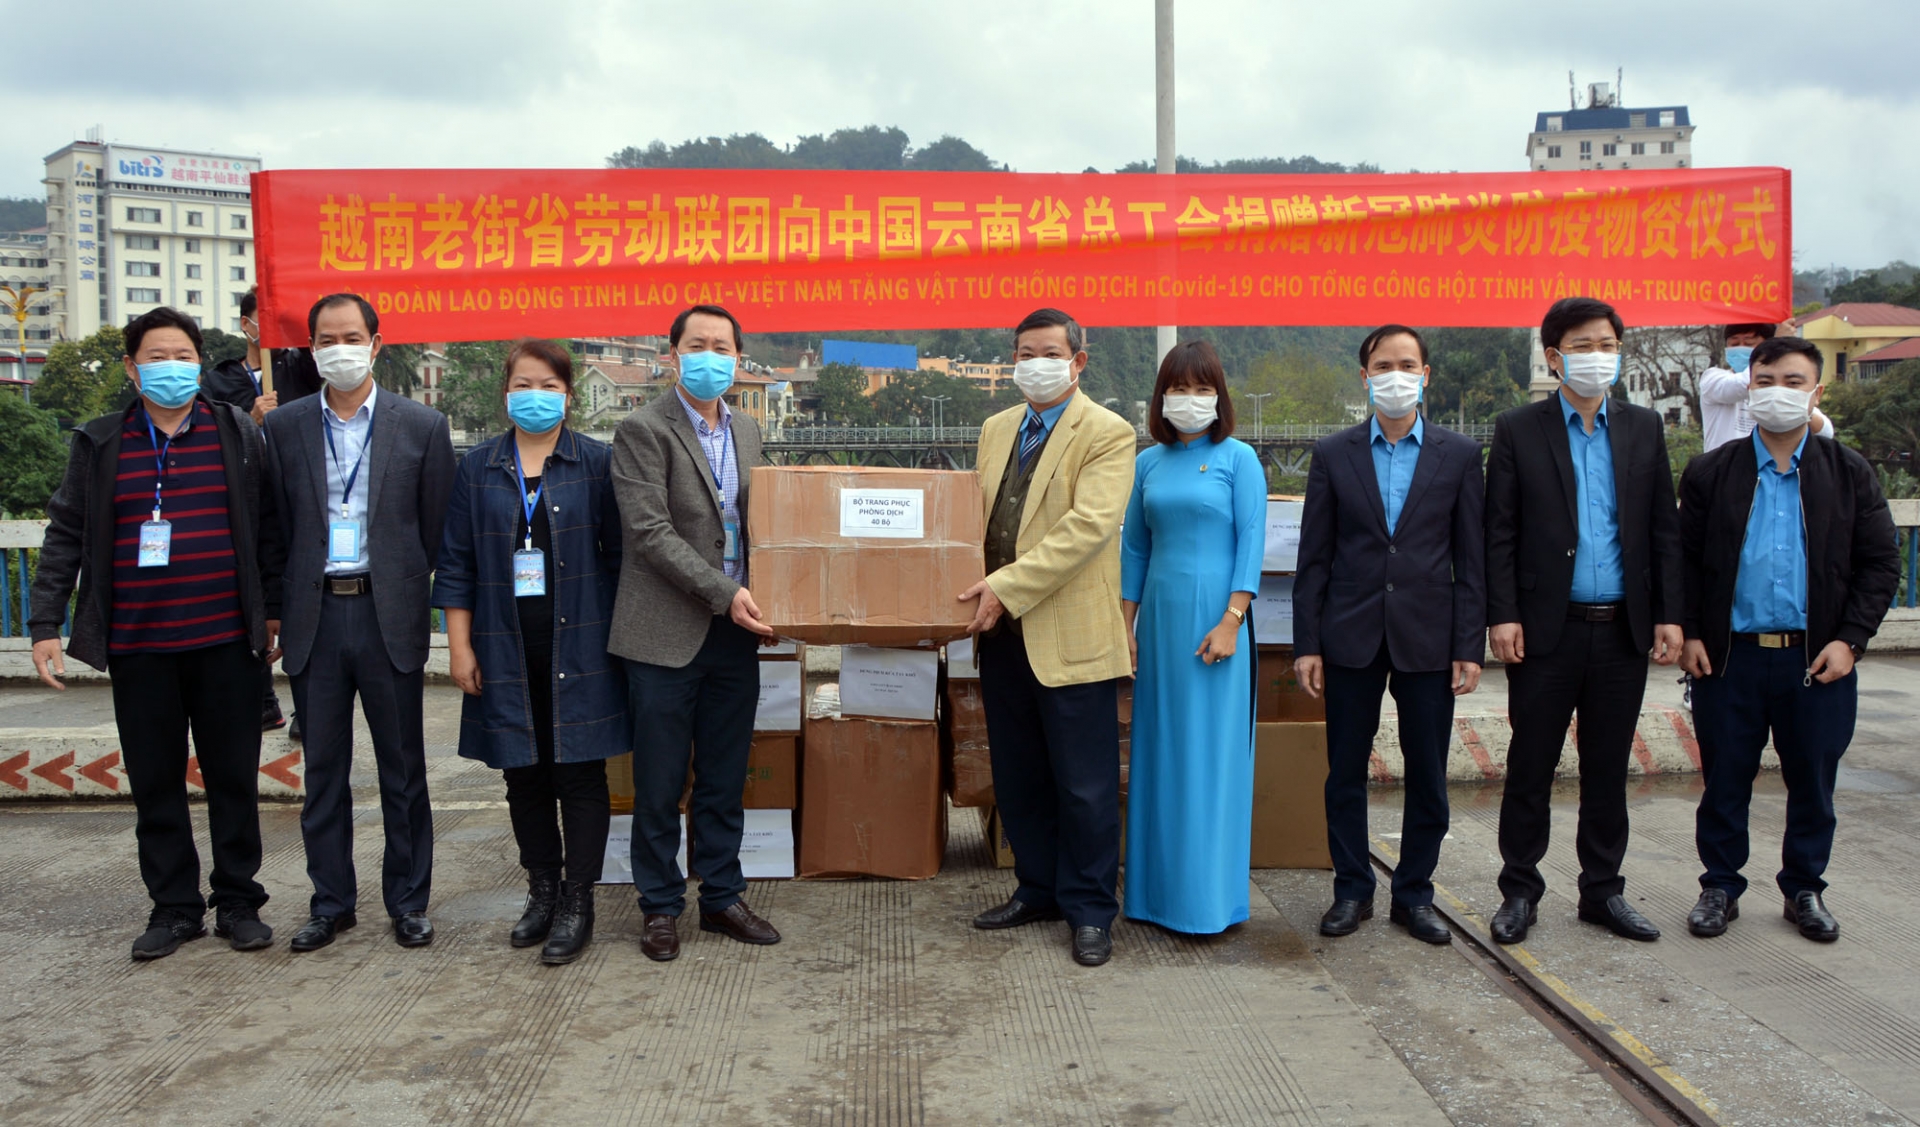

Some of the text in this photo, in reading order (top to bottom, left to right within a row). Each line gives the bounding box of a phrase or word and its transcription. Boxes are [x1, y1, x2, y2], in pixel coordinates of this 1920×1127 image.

[318, 186, 1777, 272] 越南老街省劳动联团向中国云南省总工会捐赠新冠肺炎防疫物资仪式
[377, 284, 441, 314] ĐOÀN
[449, 288, 493, 312] LAO
[498, 281, 564, 316] ĐỘNG
[634, 278, 678, 306] LÀO
[684, 274, 787, 308] CAI-VIỆT
[794, 278, 843, 302] NAM
[849, 271, 909, 307] TẶNG
[915, 269, 959, 306] VẬT
[964, 272, 994, 299] TƯ
[1000, 268, 1077, 299] CHỐNG
[1083, 274, 1138, 303] DỊCH
[1144, 274, 1253, 298] nCovid-19
[1259, 275, 1303, 298] CHO
[1309, 268, 1367, 298] TỔNG
[1373, 268, 1432, 299] CÔNG
[1437, 269, 1477, 304] HỘI
[1540, 270, 1583, 299] VÂN
[1588, 279, 1713, 302] NAM-TRUNG
[1718, 273, 1780, 307] QUỐC
